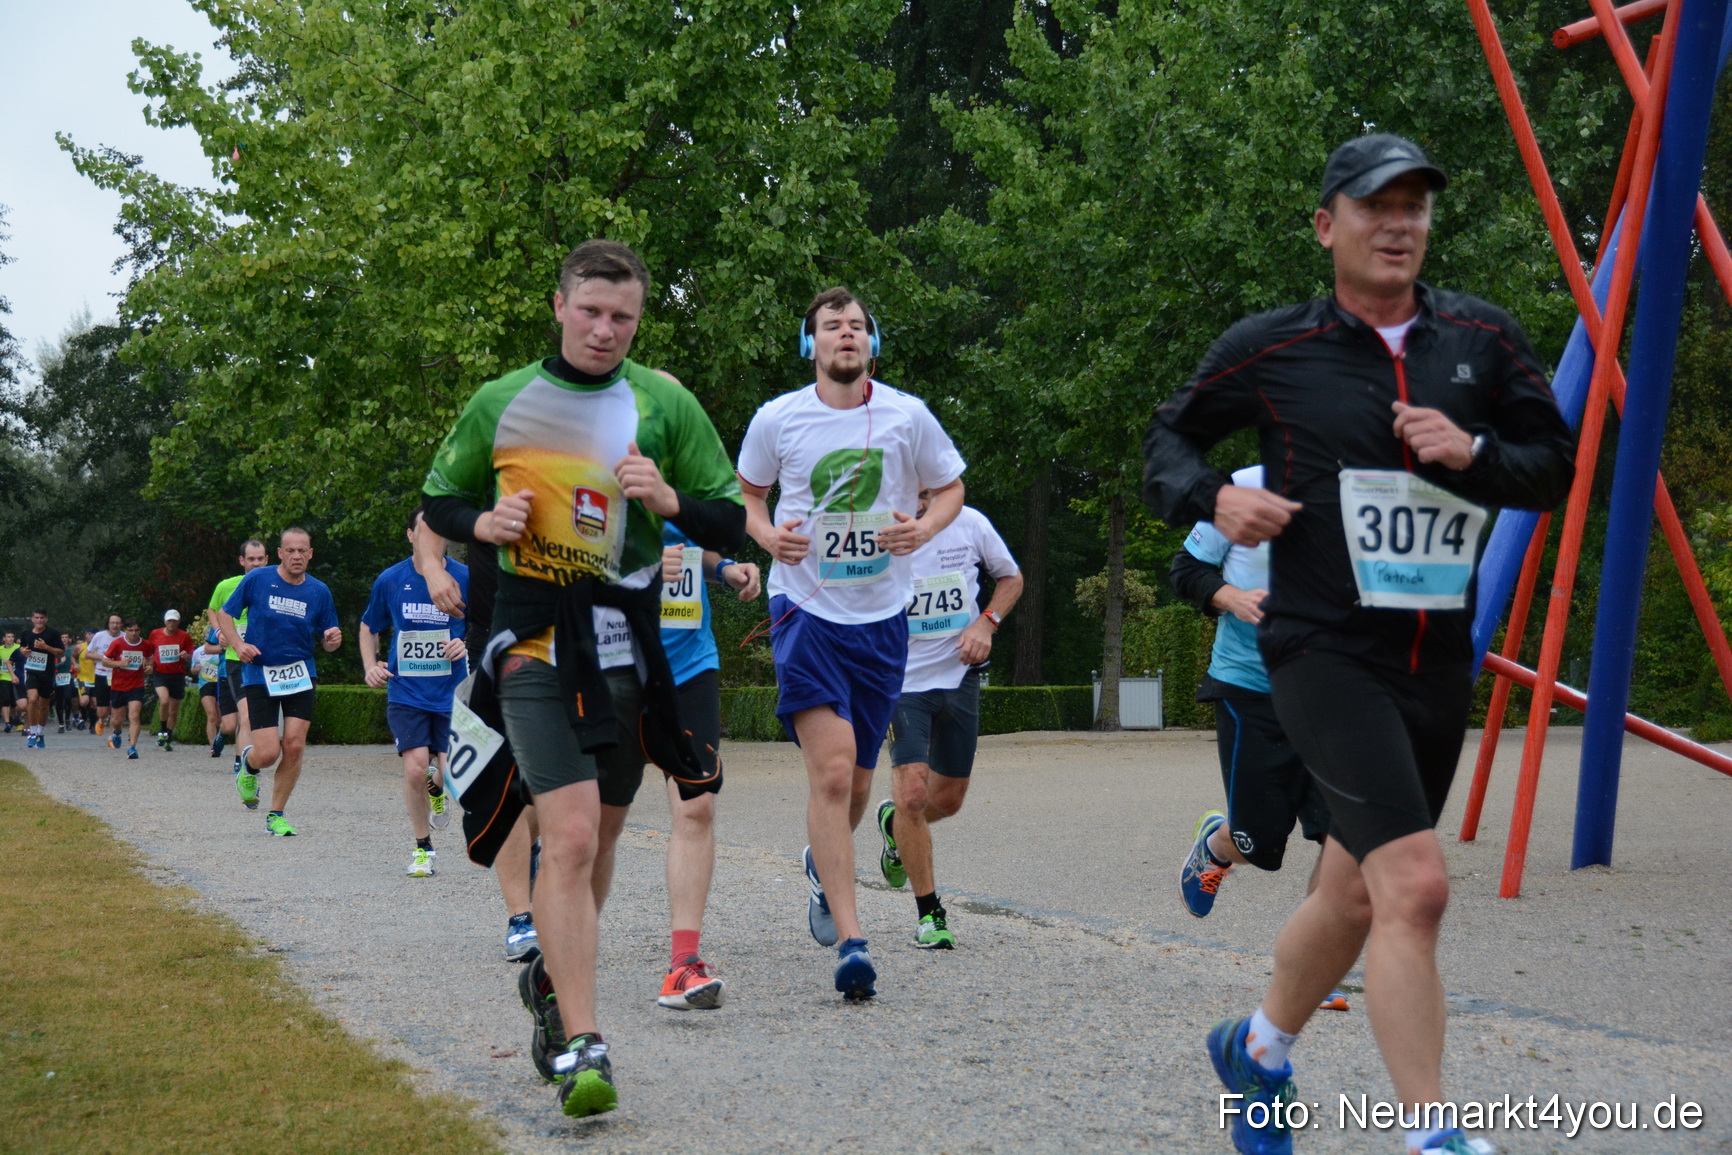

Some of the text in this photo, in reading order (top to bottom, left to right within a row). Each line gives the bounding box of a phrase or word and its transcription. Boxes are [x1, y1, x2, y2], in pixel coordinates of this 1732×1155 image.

[1357, 504, 1469, 555] 3074
[846, 565, 873, 575] Marc
[269, 595, 307, 611] HUBER
[907, 588, 963, 616] 2743
[921, 618, 951, 631] Rudolf
[161, 648, 179, 657] 2078
[403, 642, 446, 658] 2525
[28, 655, 46, 665] 2556
[409, 662, 441, 671] Christoph
[269, 664, 304, 683] 2420
